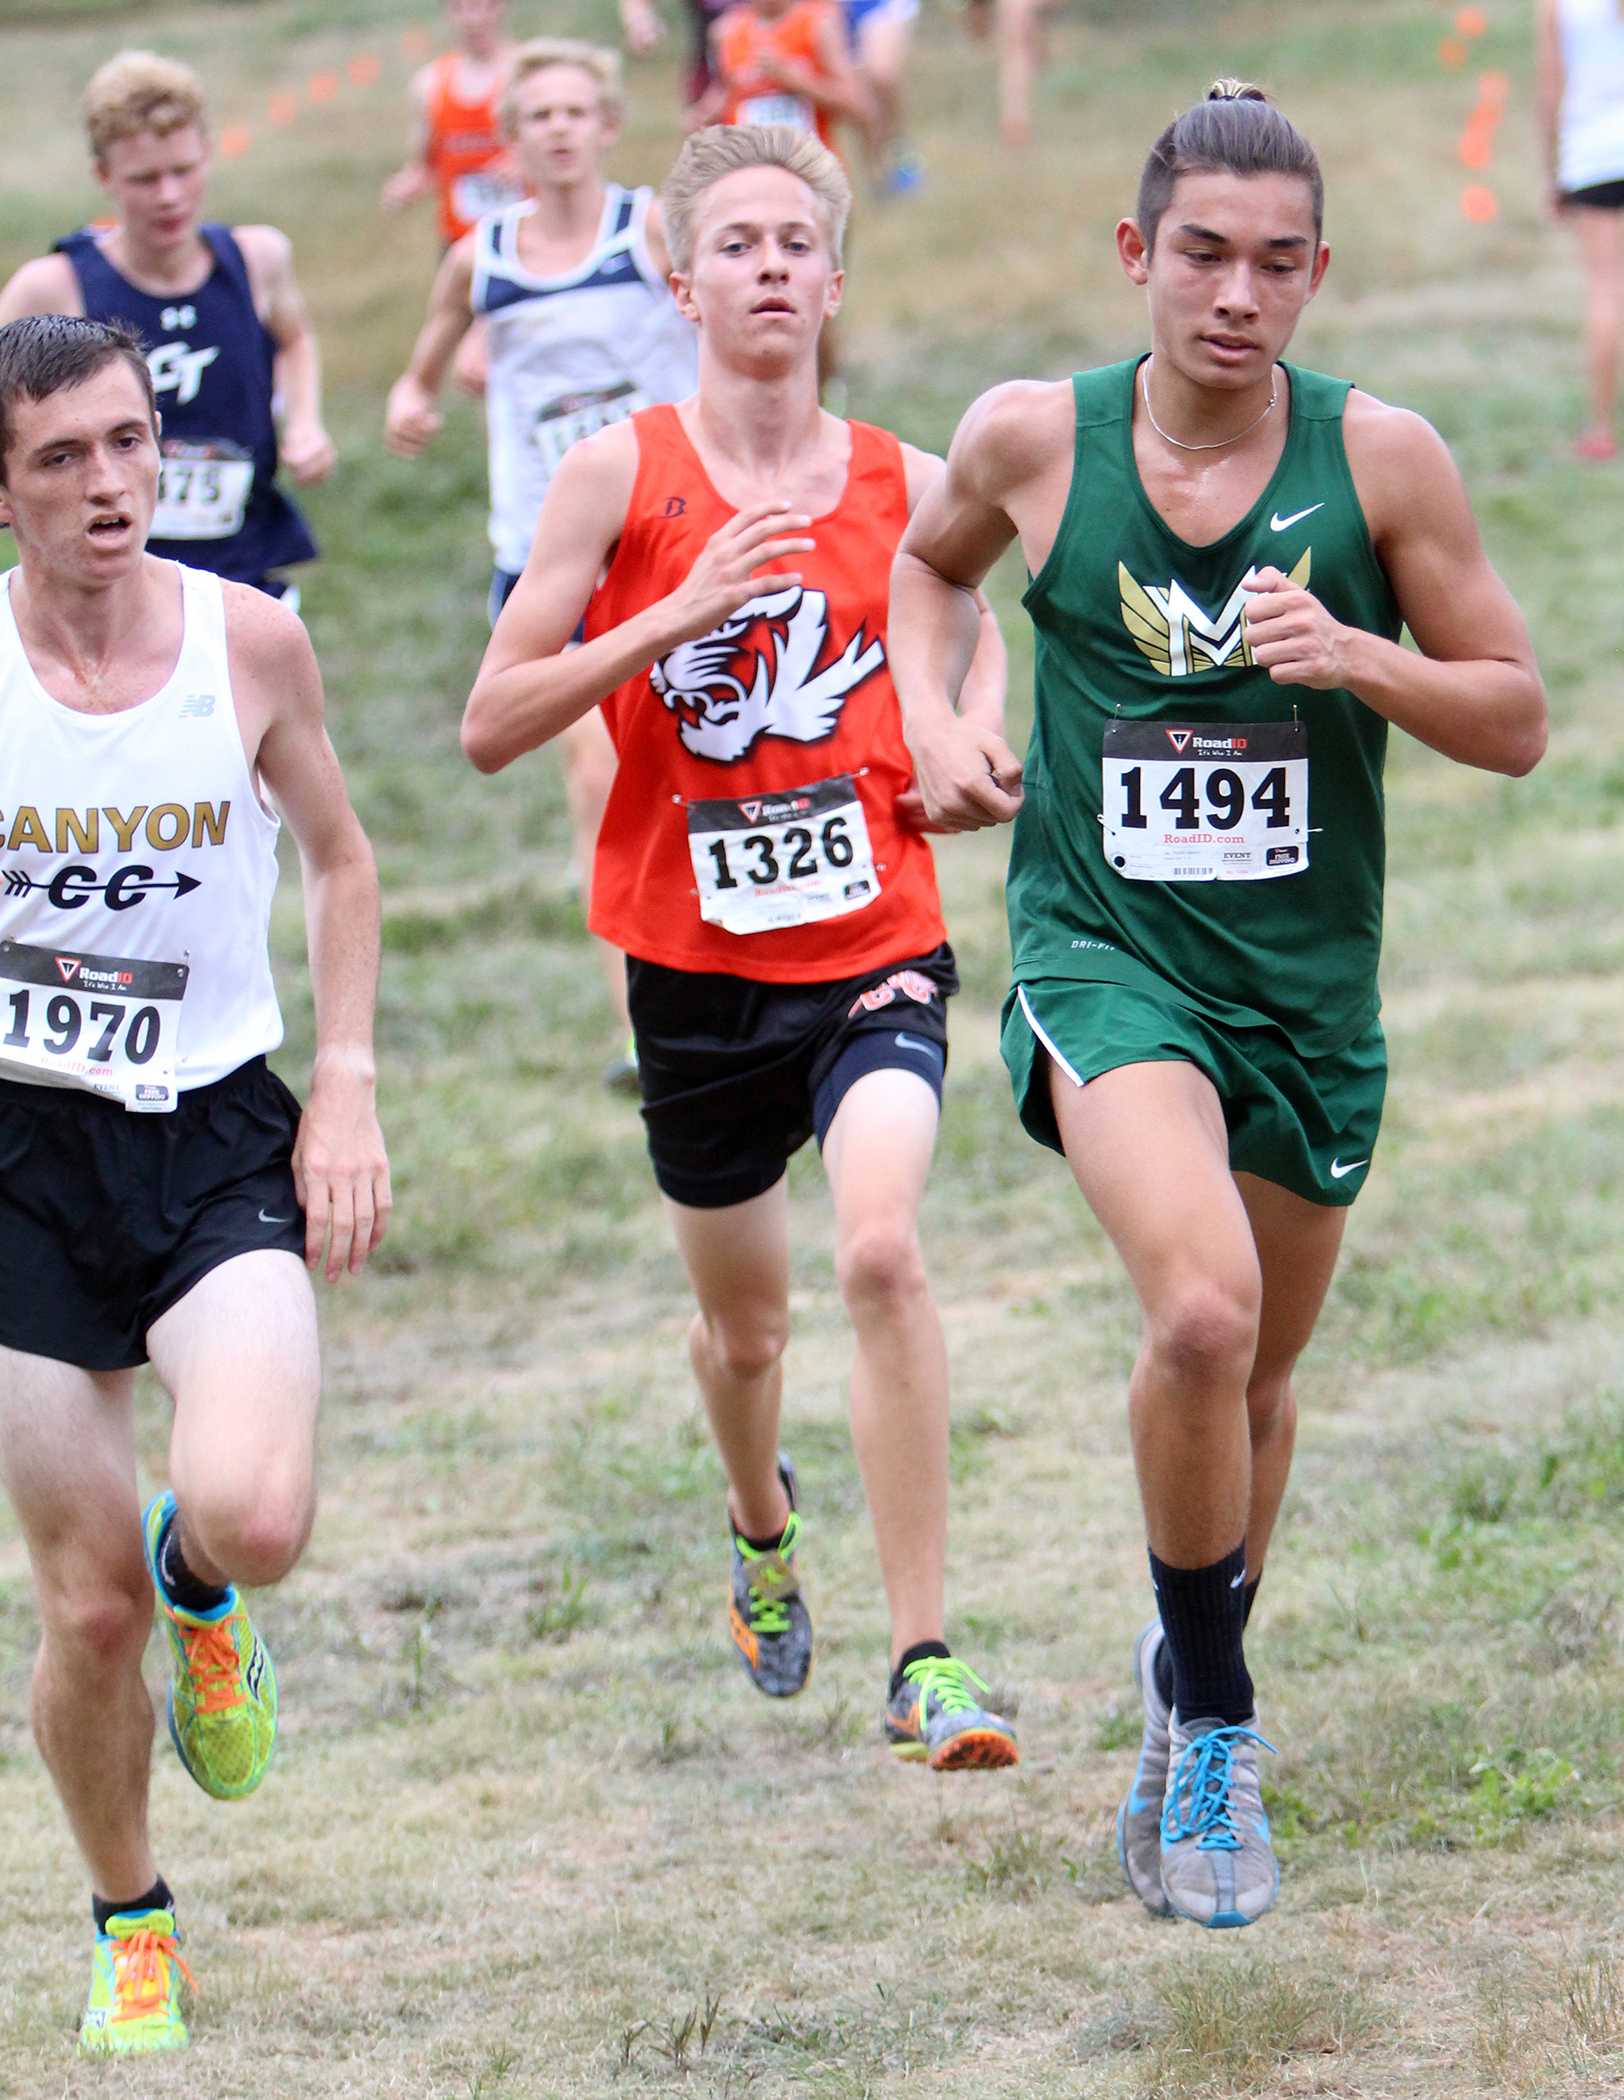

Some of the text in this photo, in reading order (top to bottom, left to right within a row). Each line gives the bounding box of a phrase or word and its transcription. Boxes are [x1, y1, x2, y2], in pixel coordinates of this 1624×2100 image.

[1192, 736, 1248, 750] RoadID
[1120, 766, 1291, 831] 1494
[0, 800, 231, 855] ANYON
[709, 816, 854, 890] 1326
[1163, 833, 1245, 845] RoadID.com
[1223, 852, 1251, 860] EVENT
[3, 989, 161, 1065] 1970
